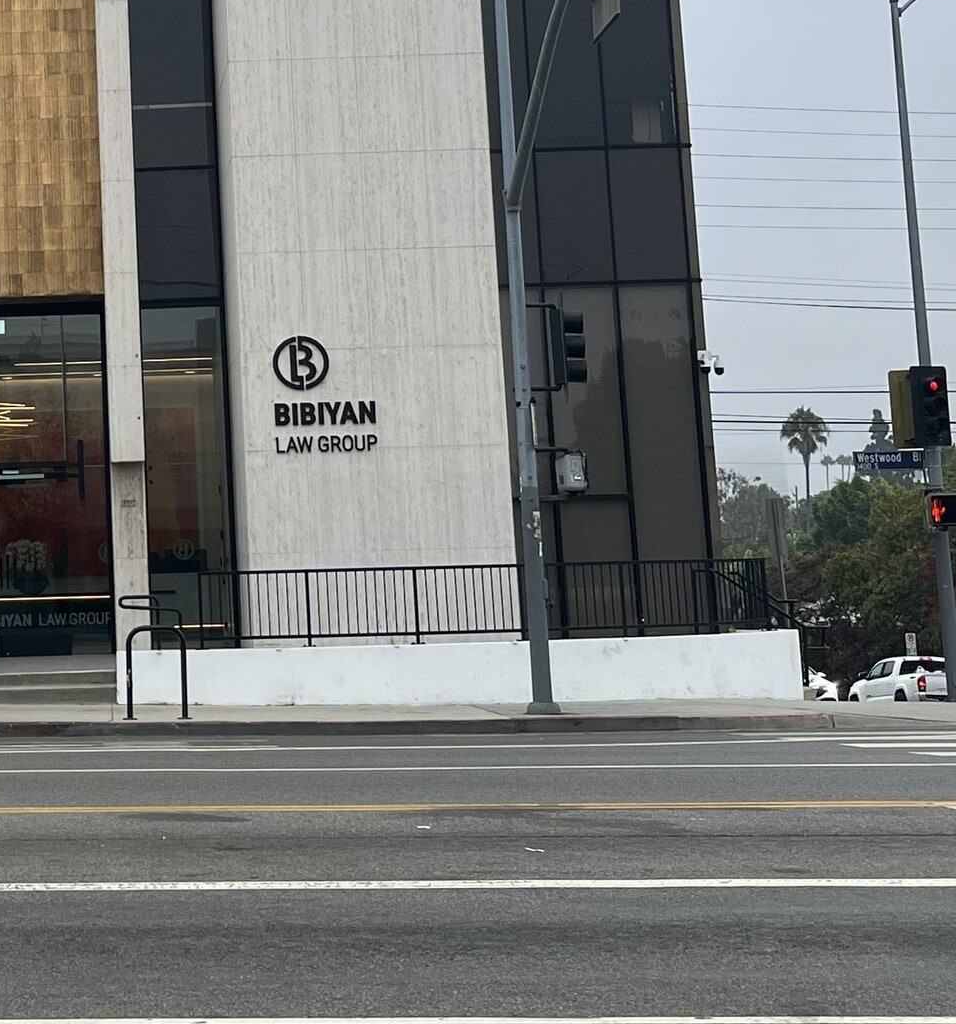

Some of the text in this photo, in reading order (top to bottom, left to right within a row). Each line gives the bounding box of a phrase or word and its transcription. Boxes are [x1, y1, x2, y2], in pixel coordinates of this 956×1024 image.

[274, 401, 376, 426] BIBIYAN
[275, 434, 378, 454] LAW GROUP
[857, 452, 902, 463] Westwood
[39, 613, 67, 626] LAW
